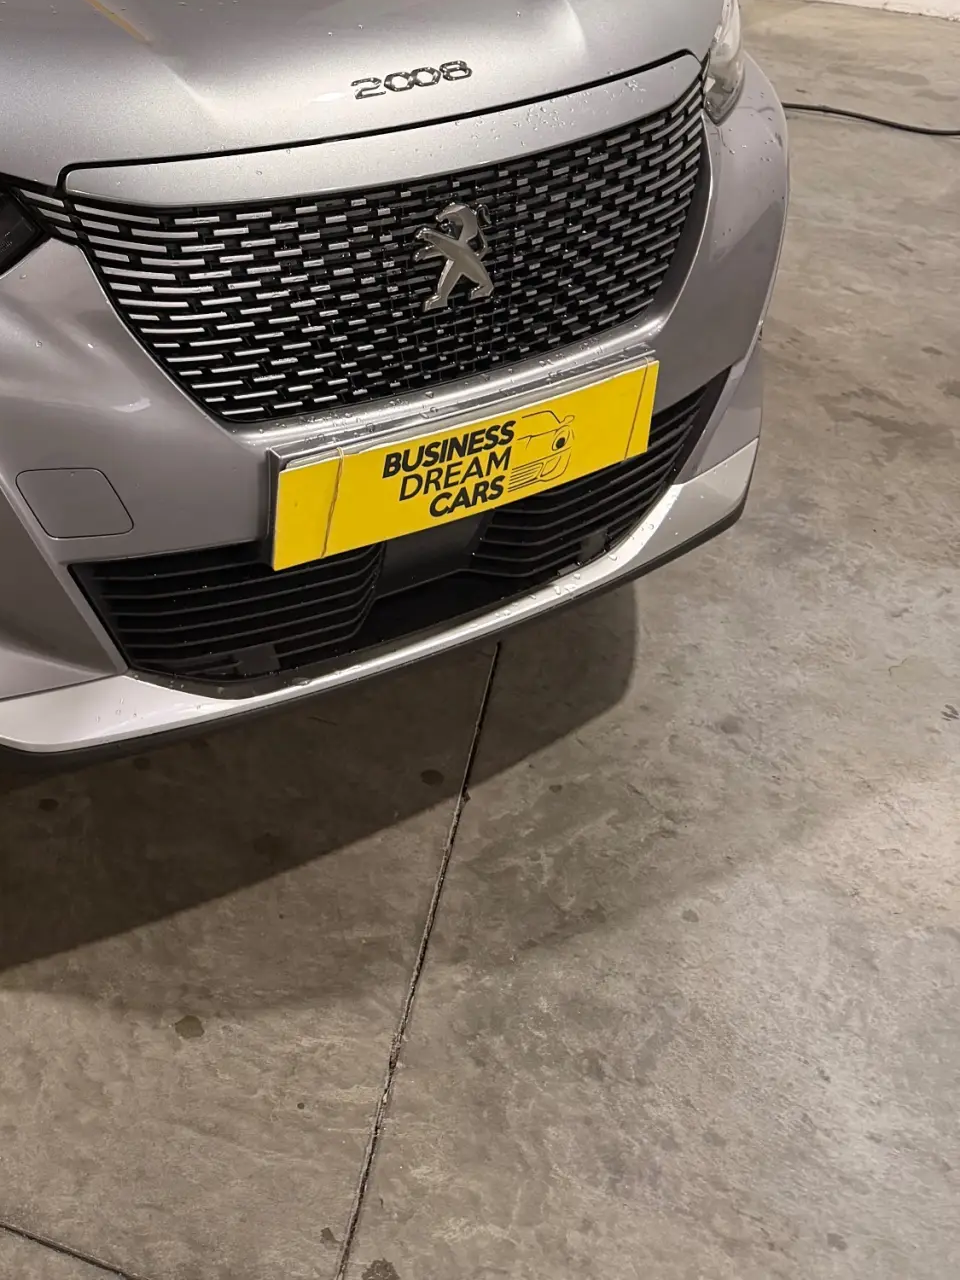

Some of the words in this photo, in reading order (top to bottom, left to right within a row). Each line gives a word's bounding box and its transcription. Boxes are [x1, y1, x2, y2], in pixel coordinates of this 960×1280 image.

[351, 60, 473, 100] 2008
[383, 420, 516, 478] BUSINESS
[399, 447, 512, 501] DREAM
[430, 476, 505, 517] CARS
